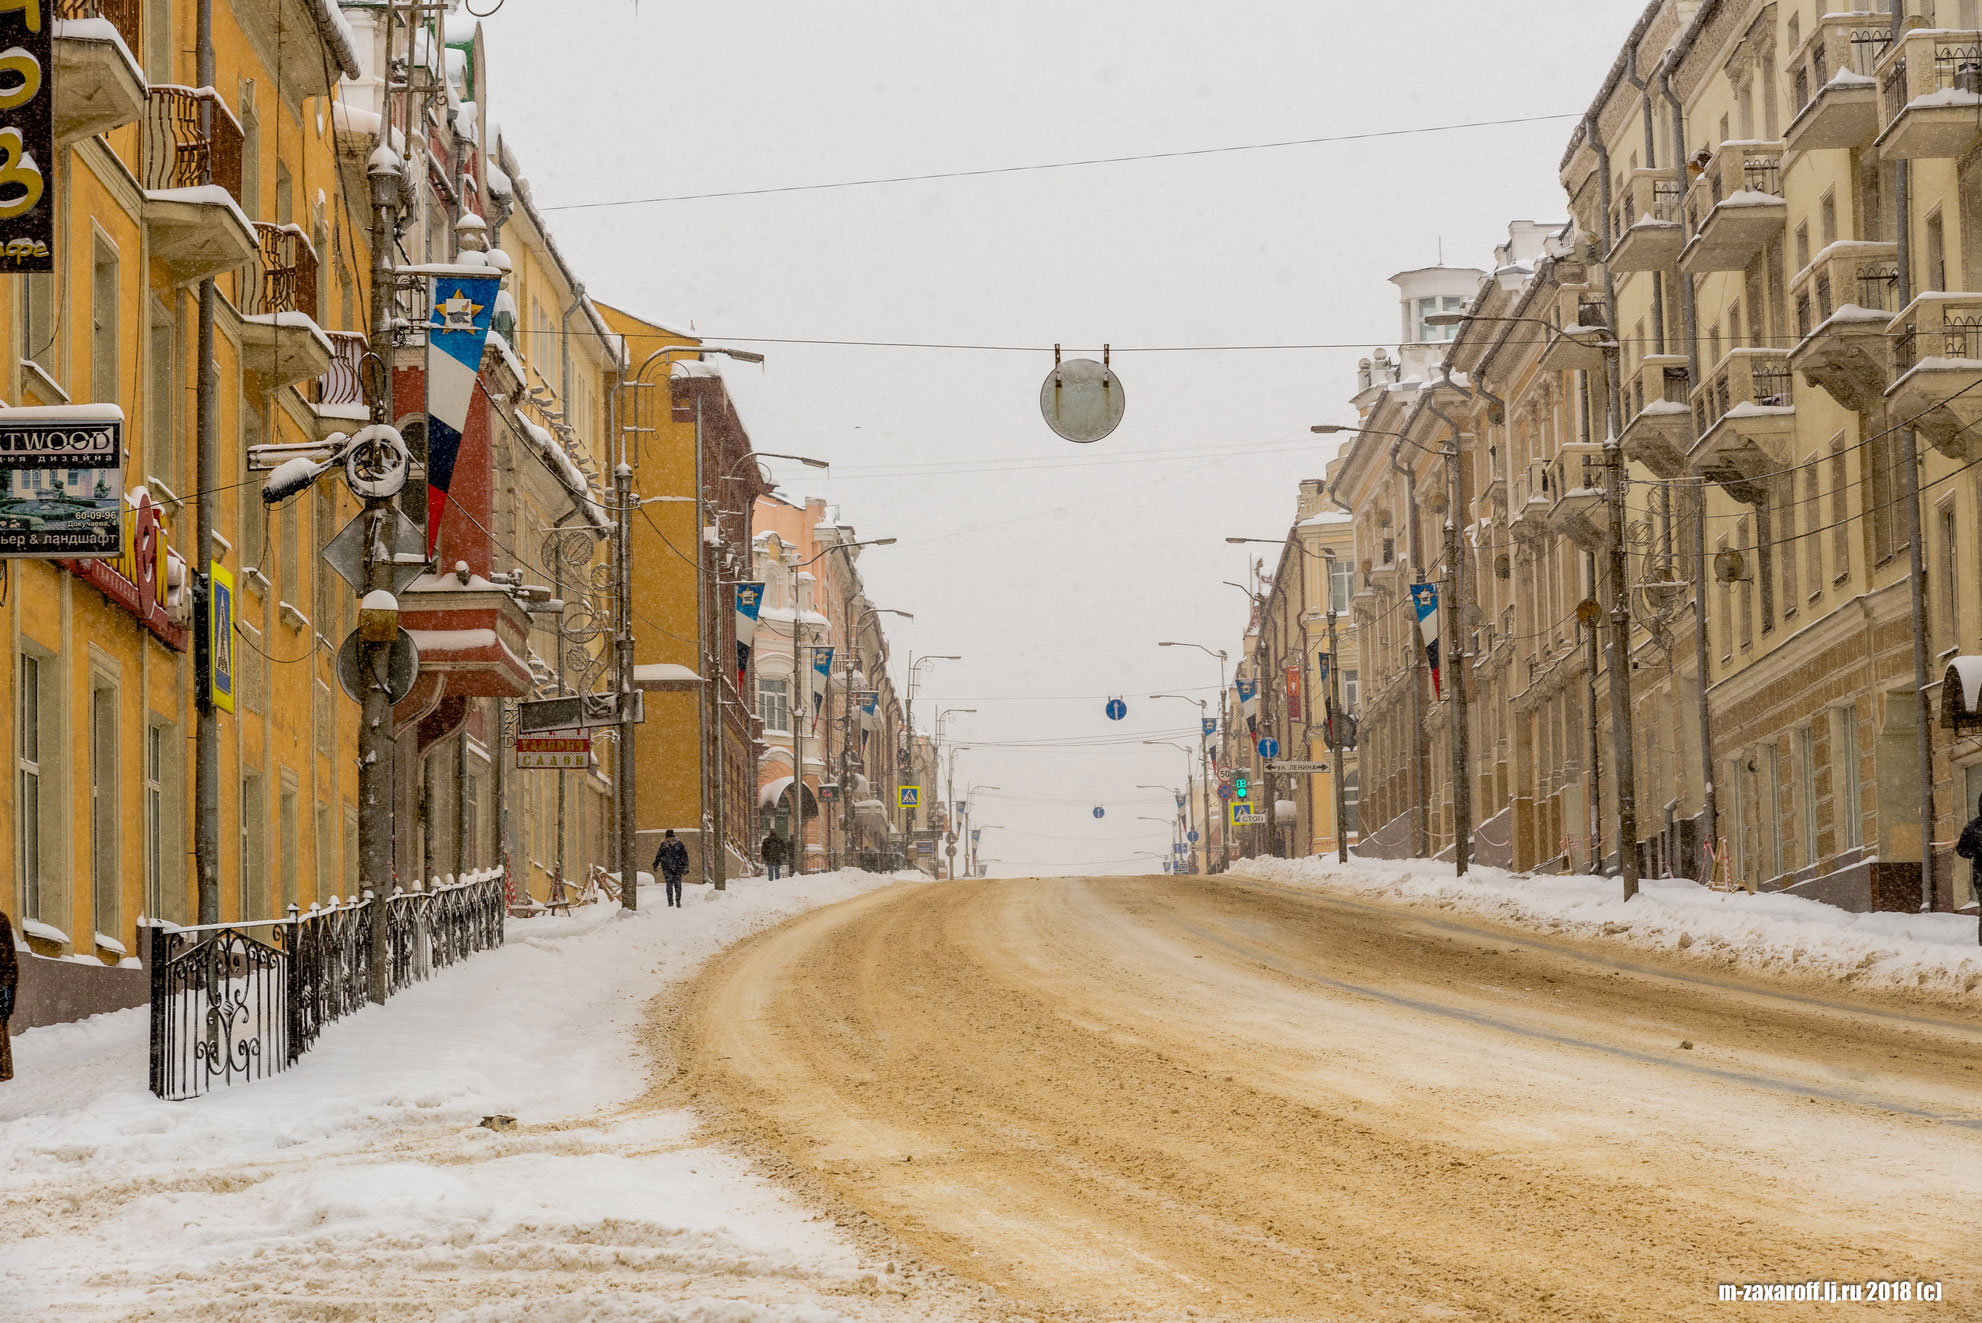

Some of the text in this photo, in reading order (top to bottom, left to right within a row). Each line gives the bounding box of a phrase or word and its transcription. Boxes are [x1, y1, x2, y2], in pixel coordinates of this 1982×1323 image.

[0, 431, 110, 451] TWOOD
[0, 454, 113, 463] ия дизайна
[75, 511, 117, 520] 60-09-96
[29, 534, 39, 545] &
[43, 532, 117, 546] ландшафт
[522, 755, 584, 766] САЛОН
[1220, 770, 1230, 778] 50
